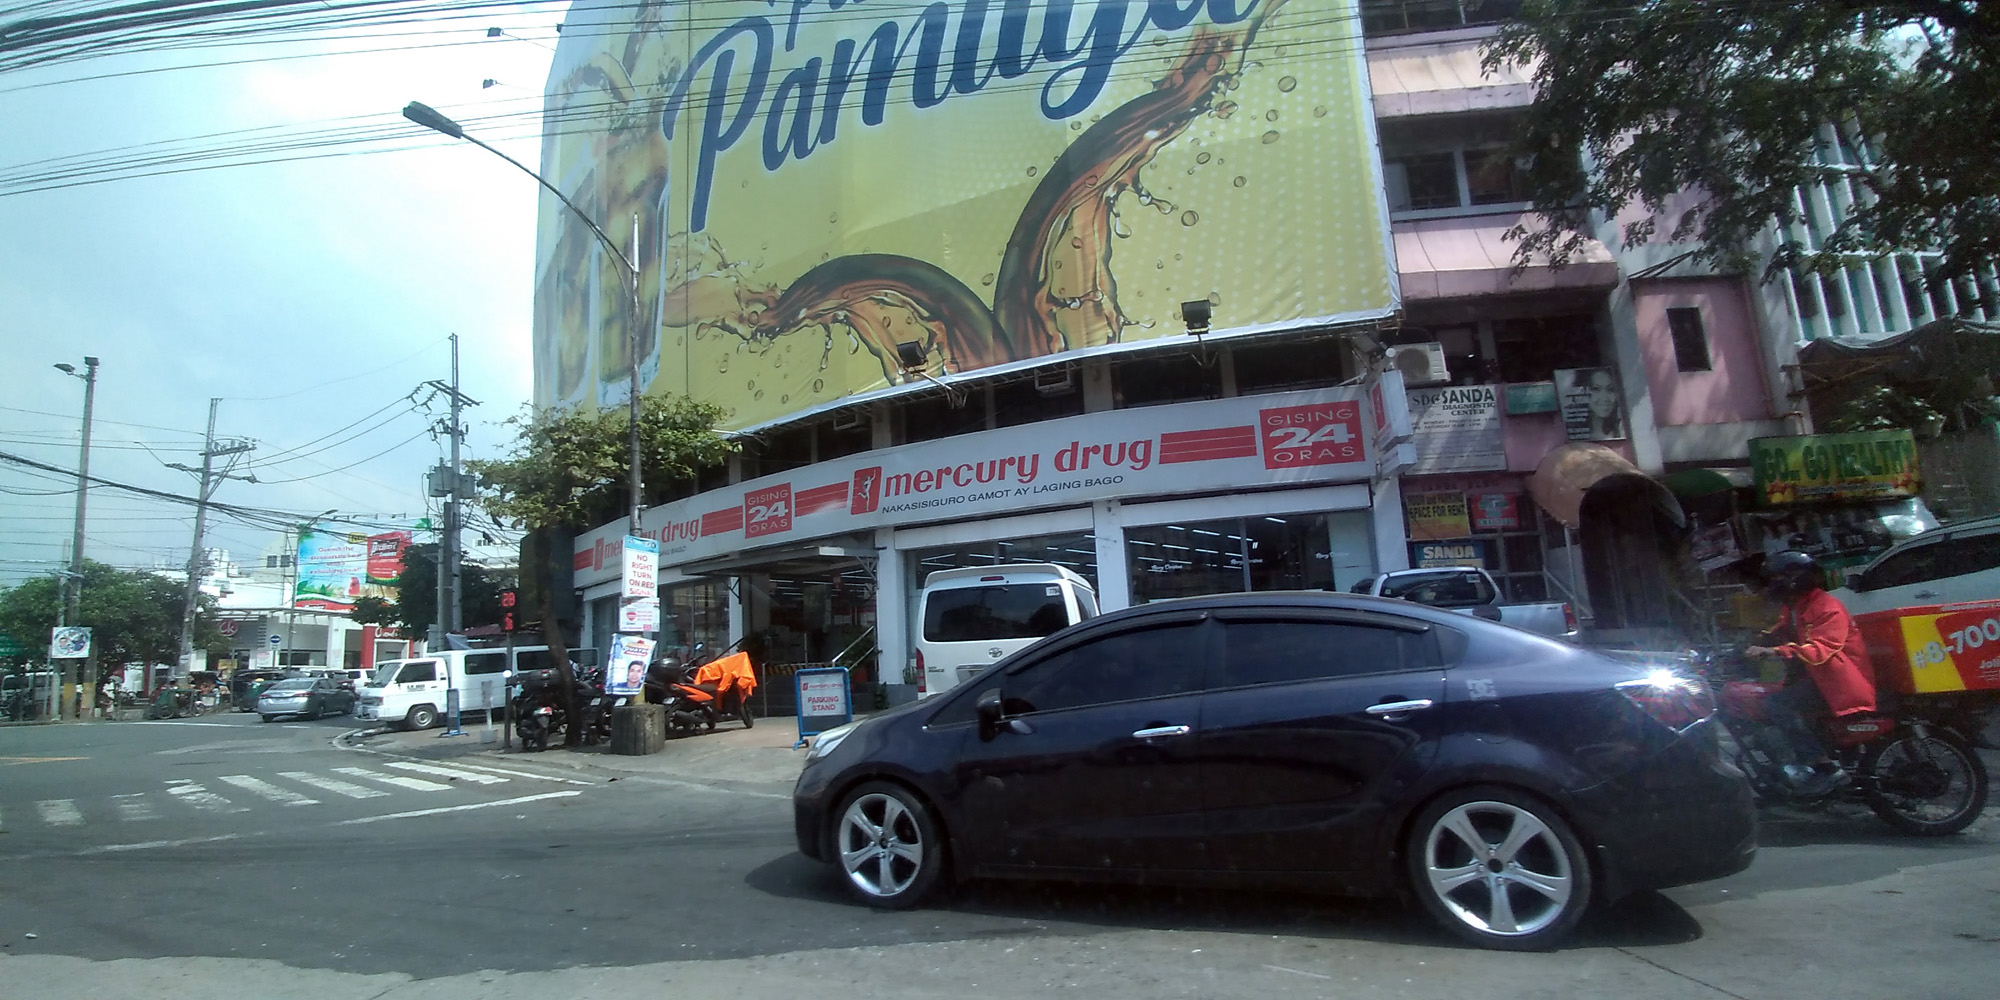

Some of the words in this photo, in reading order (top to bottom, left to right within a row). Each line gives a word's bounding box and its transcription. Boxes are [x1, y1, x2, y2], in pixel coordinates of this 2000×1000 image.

[1441, 388, 1496, 405] SANDA
[1442, 402, 1496, 411] DIAGNOSTIC
[1450, 408, 1485, 417] CENTER
[1267, 408, 1353, 426] GISING
[1269, 423, 1355, 450] 24
[1273, 446, 1355, 463] ORAS
[884, 453, 1040, 498] mercury
[1054, 438, 1153, 473] drug
[747, 489, 789, 506] GISING
[882, 495, 966, 514] NAKASISIGURO
[968, 489, 1012, 503] GAMOT
[1014, 486, 1031, 497] AY
[1033, 479, 1082, 494] LAGING
[1084, 475, 1124, 488] BAGO
[748, 501, 789, 524] 24
[661, 519, 700, 543] drug
[749, 518, 788, 534] ORAS
[636, 554, 648, 562] NO
[1423, 545, 1476, 560] SANDA
[631, 561, 653, 571] RIGHT
[632, 570, 652, 580] TURN
[629, 578, 640, 587] ON
[641, 580, 655, 589] RED
[807, 696, 839, 704] PARKING
